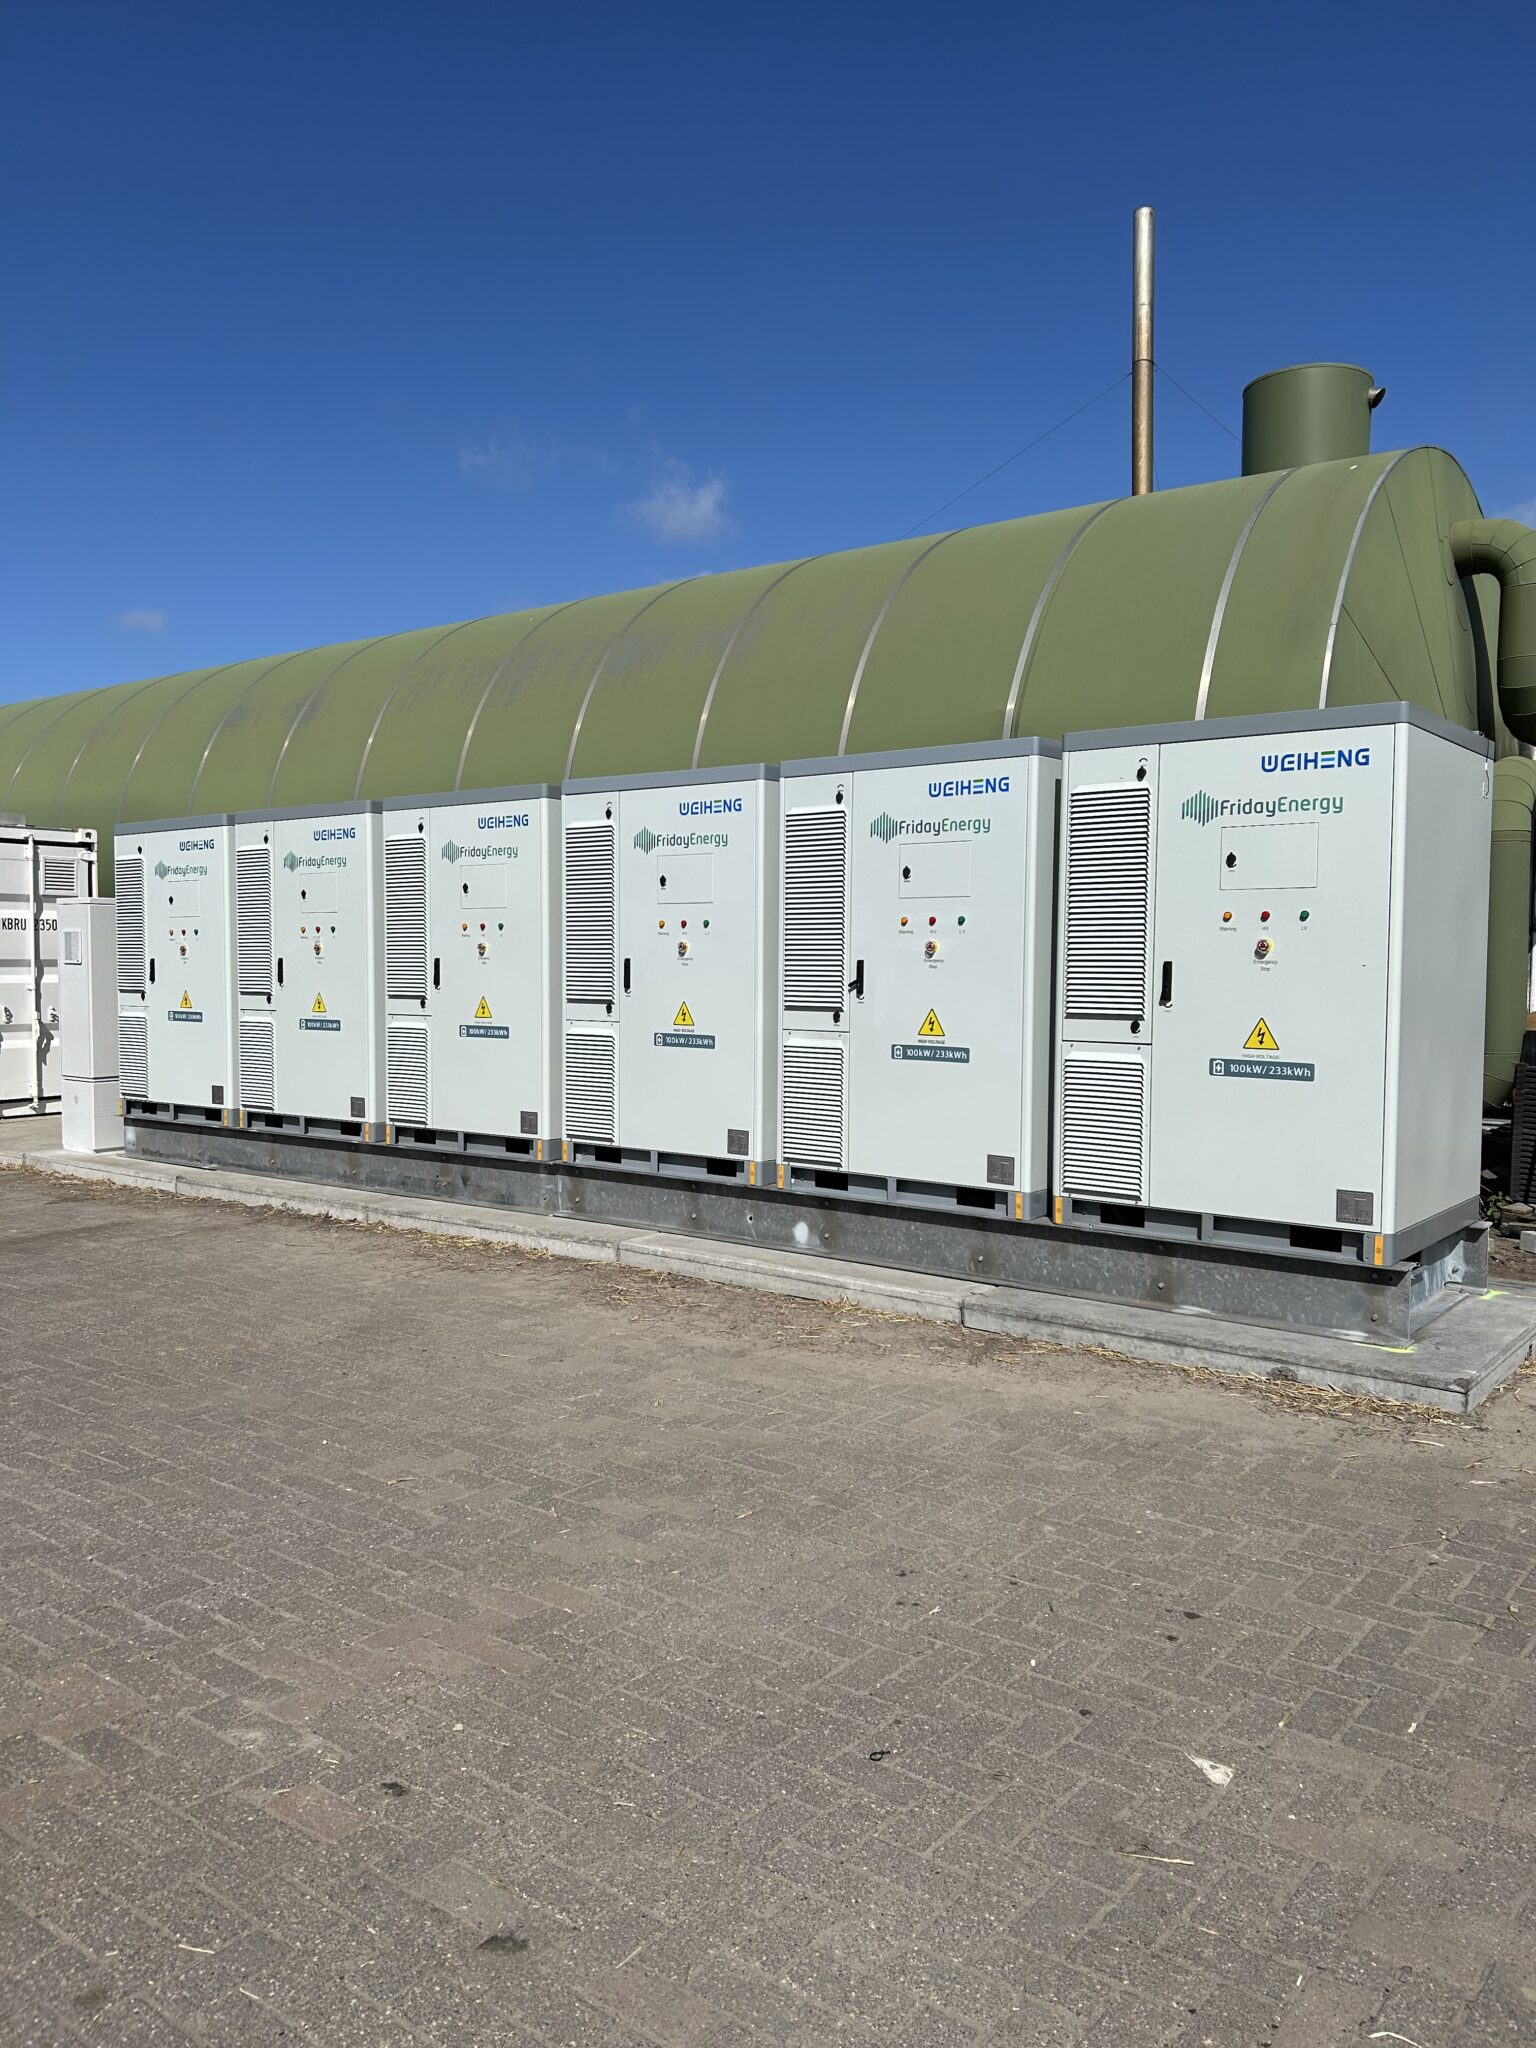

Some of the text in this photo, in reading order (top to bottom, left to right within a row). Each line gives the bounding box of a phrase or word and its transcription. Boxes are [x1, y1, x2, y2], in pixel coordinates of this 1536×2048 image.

[1260, 748, 1370, 773] WEIHENG
[928, 776, 1010, 798] WEIHENG
[679, 798, 742, 816] WEIHENG
[1220, 796, 1344, 817] FridayEnergy
[477, 814, 529, 829] WEIHENG
[899, 818, 991, 836] FridayEnergy
[313, 827, 356, 841] WEIHENG
[656, 833, 728, 848] FridayEnergy
[179, 839, 215, 851] WEIHENG
[460, 845, 518, 860] FridayEnergy
[1, 918, 27, 931] KBRU
[935, 1050, 967, 1060] 233kWh
[1269, 1066, 1311, 1077] 233kWh
